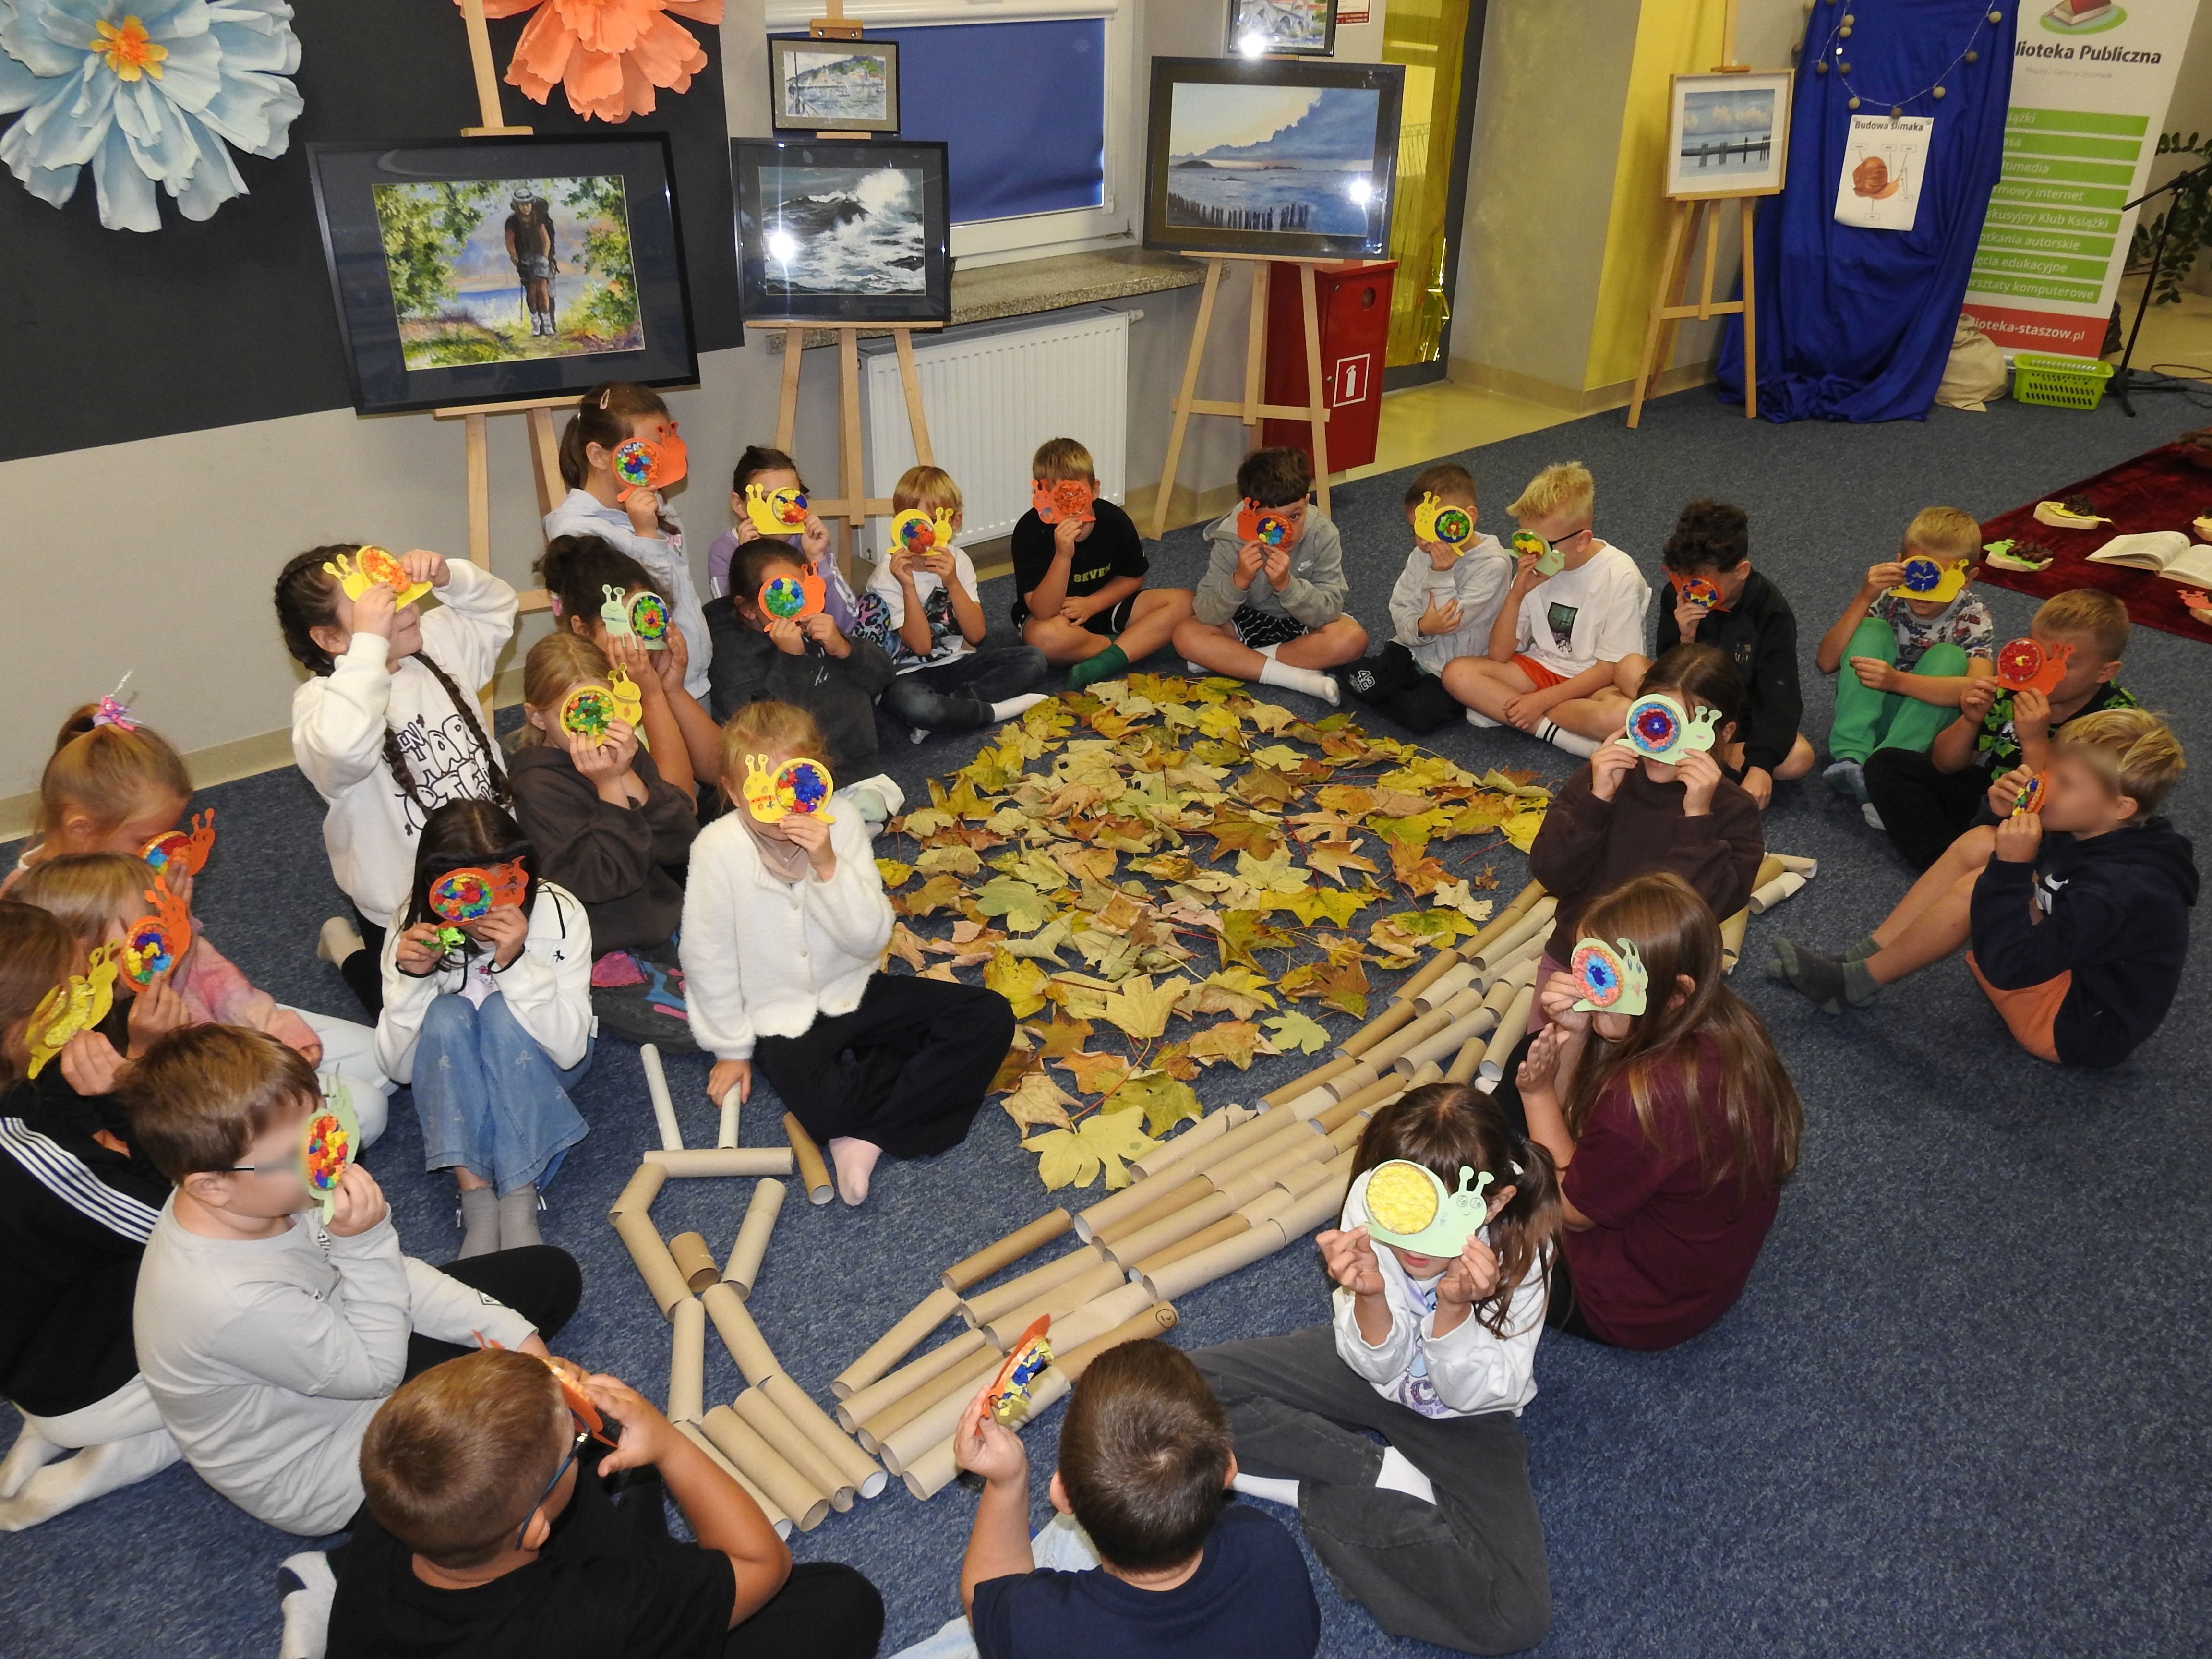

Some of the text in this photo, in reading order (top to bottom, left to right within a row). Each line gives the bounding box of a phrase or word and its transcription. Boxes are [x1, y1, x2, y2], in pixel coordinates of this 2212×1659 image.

[2015, 41, 2162, 64] lioteka Publiczna
[1855, 120, 1923, 131] Budowa ślimaka
[2002, 160, 2050, 174] ltimedia
[1992, 186, 2084, 202] rmowy internet
[1986, 208, 2036, 225] skusyjny
[2038, 213, 2065, 225] Klub
[2024, 237, 2080, 251] autorskie
[2001, 257, 2068, 274] edukacyjne
[2012, 281, 2094, 300] komputerowe
